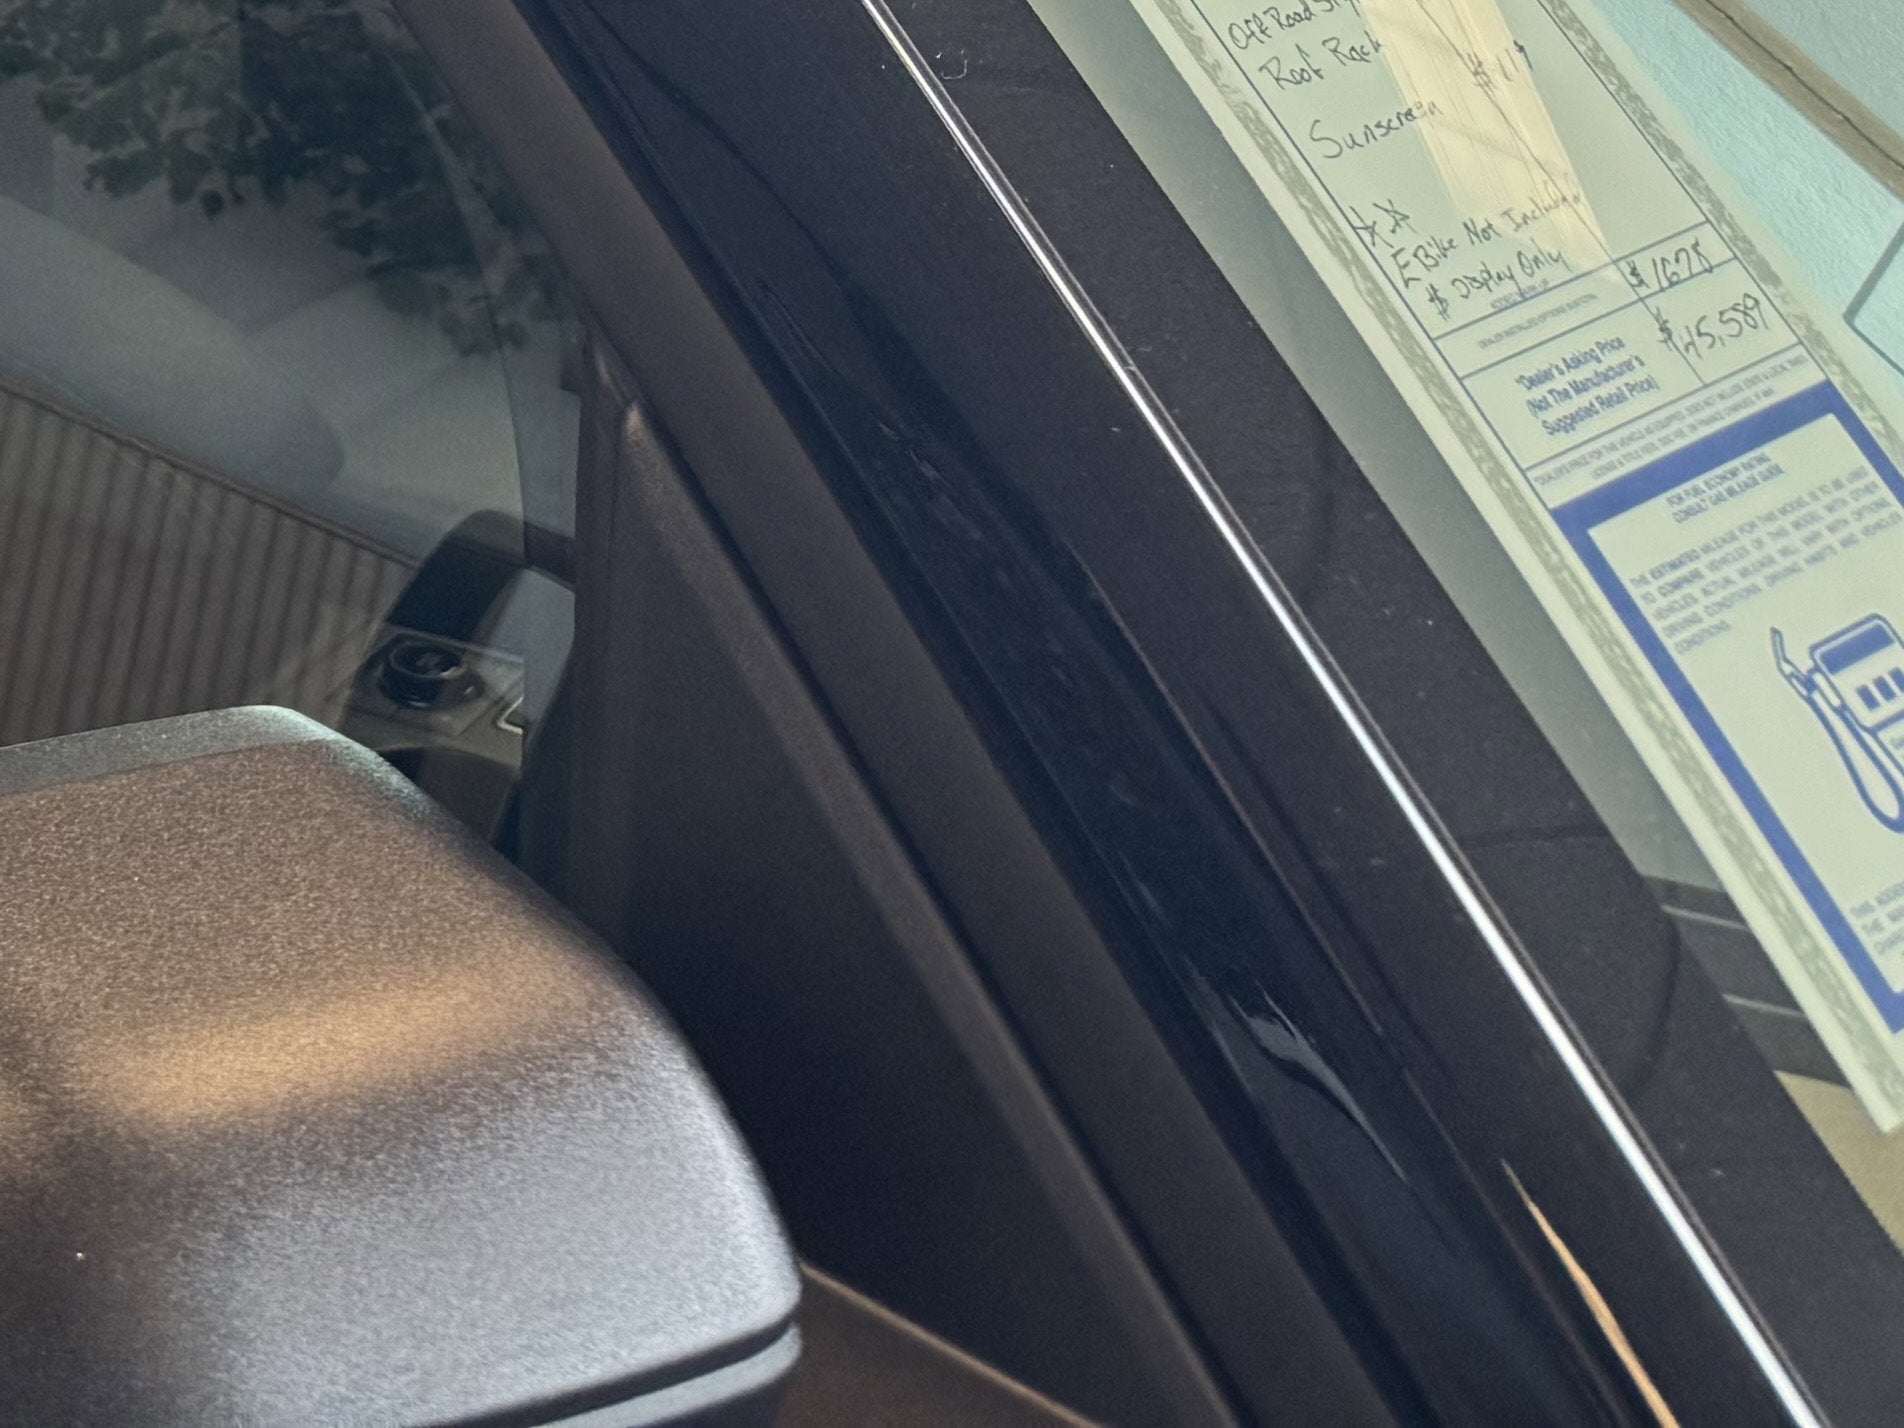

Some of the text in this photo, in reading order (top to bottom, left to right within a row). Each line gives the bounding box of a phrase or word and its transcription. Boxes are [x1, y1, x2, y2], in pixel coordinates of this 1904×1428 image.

[1462, 217, 1503, 247] Not
[1561, 348, 1604, 374] Asking
[1594, 336, 1627, 357] Price
[1526, 355, 1646, 419] (Not The Manufacturer's
[1541, 374, 1661, 437] Suggested Retail Price)
